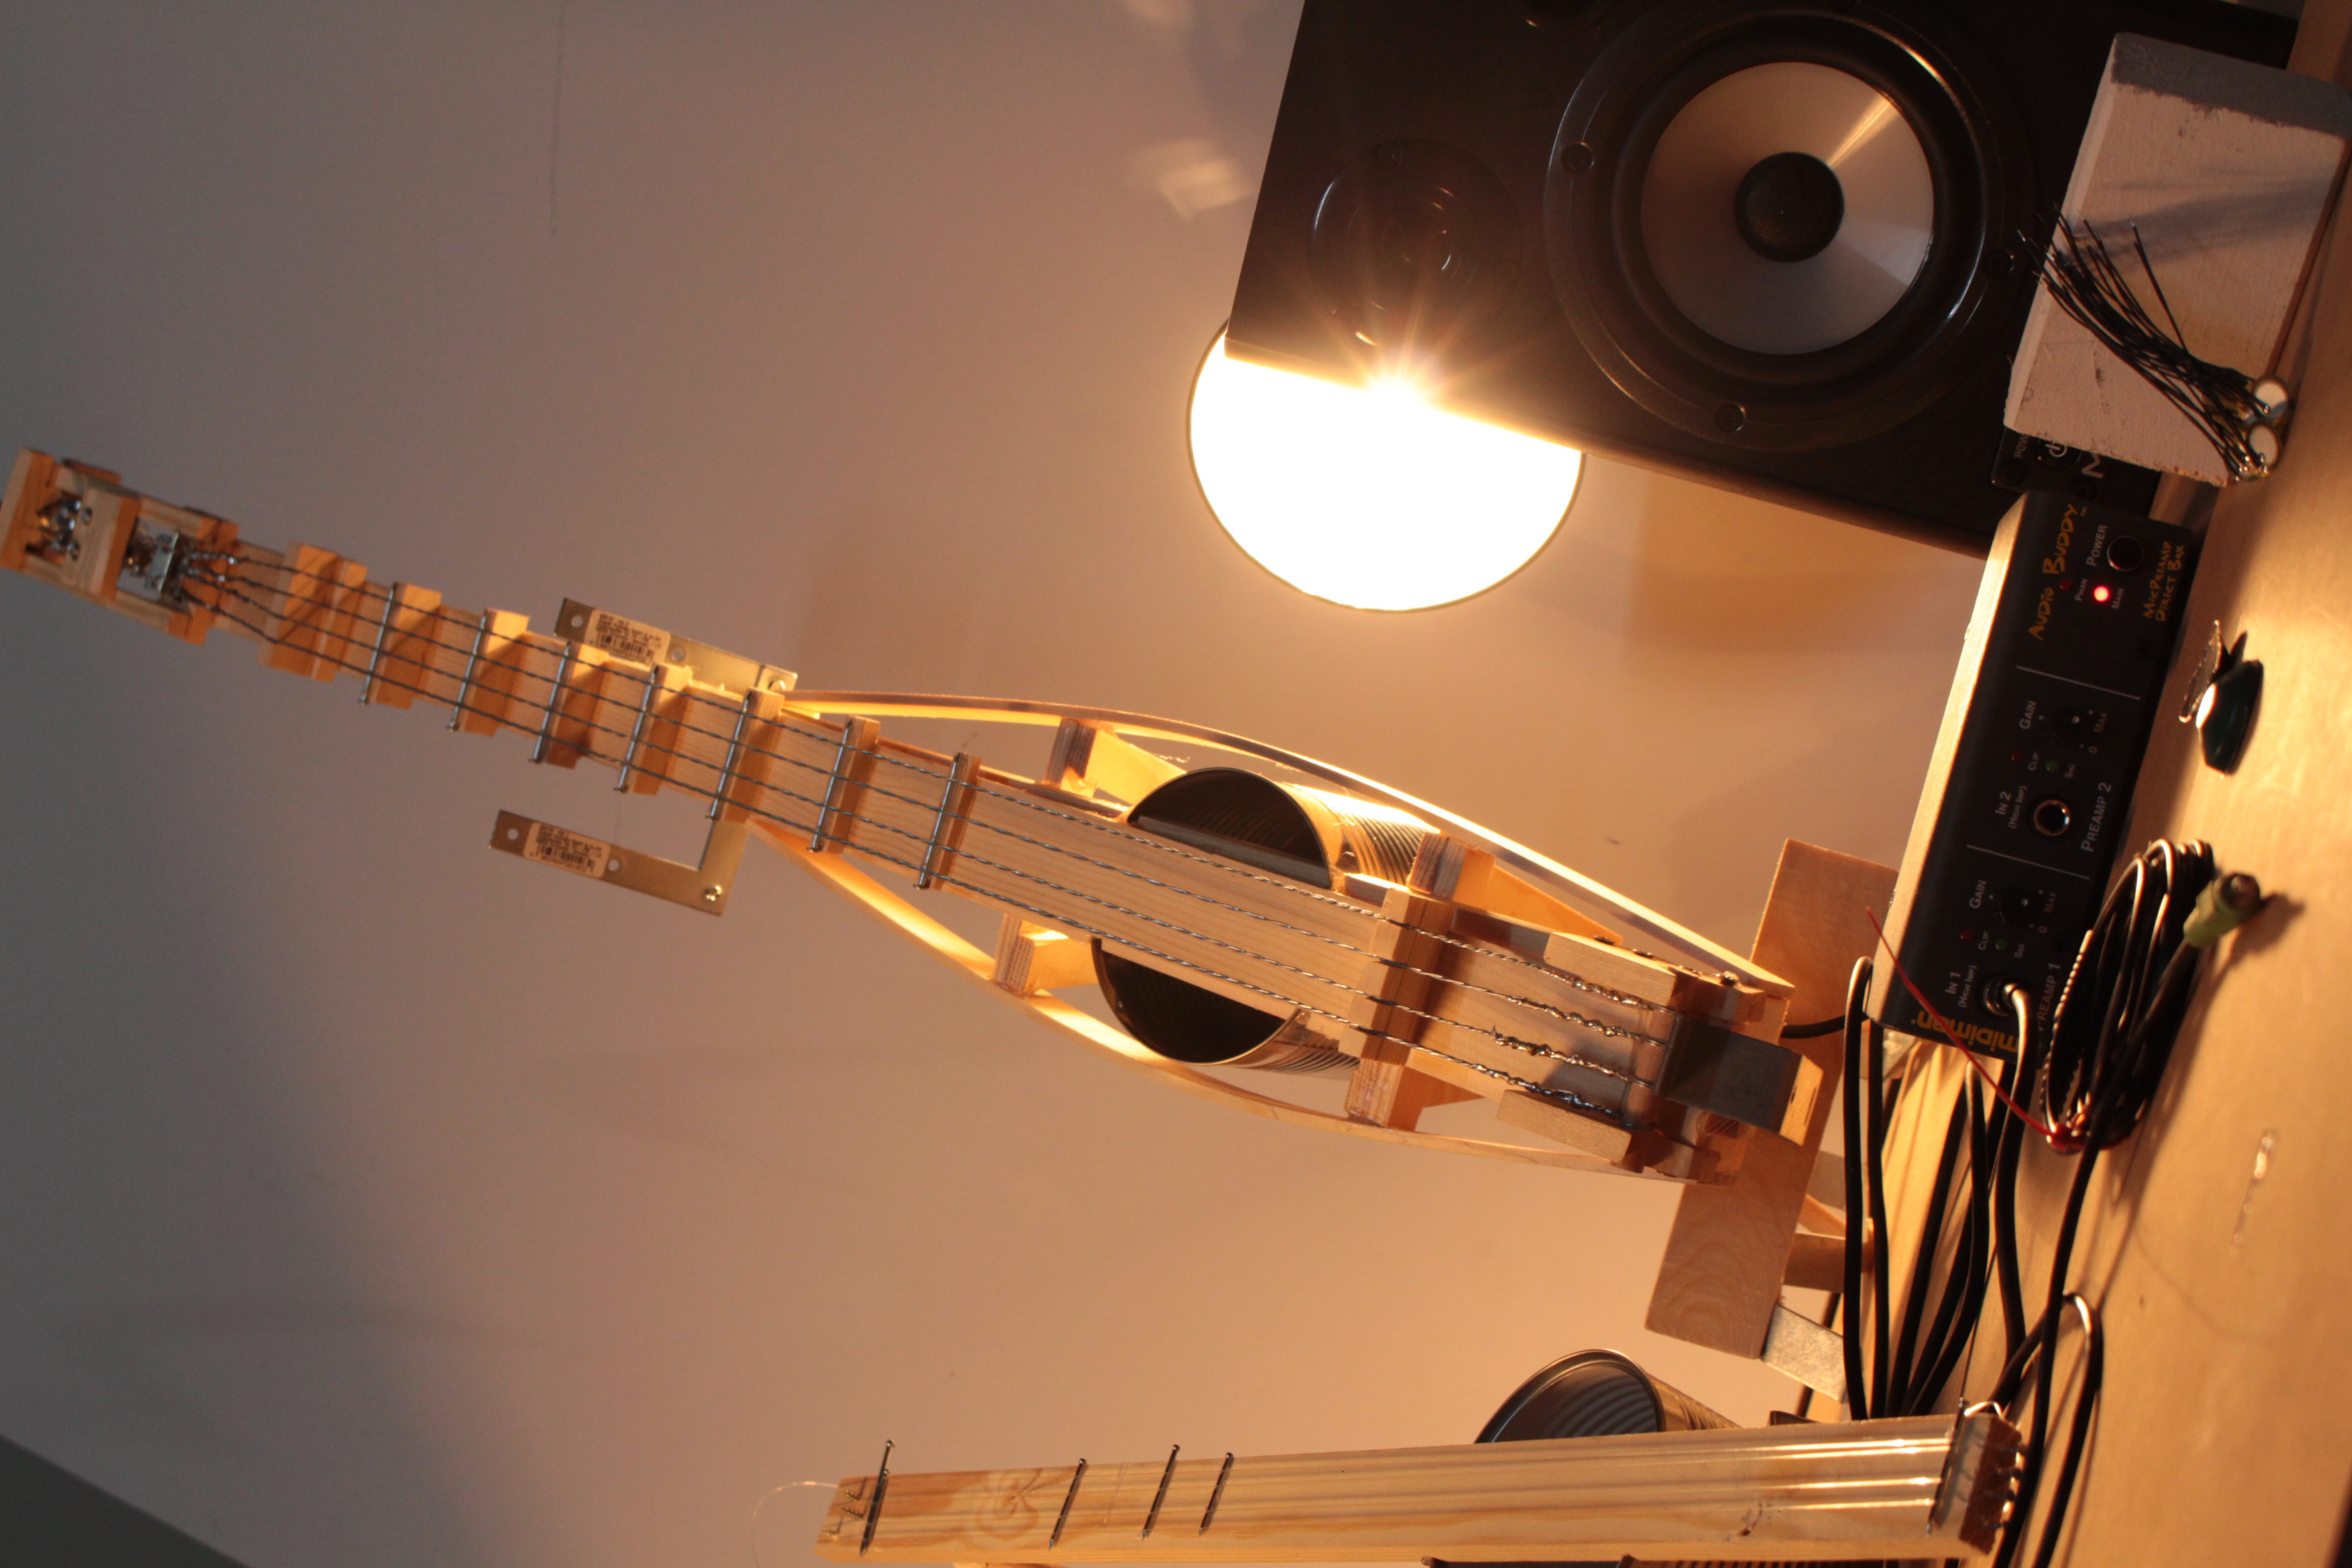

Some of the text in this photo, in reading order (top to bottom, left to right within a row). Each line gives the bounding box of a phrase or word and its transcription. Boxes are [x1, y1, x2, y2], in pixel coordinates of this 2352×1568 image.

[2043, 503, 2078, 575] BUDDY
[2086, 525, 2107, 567] POWER
[2074, 578, 2088, 602] PHAN
[2111, 587, 2123, 610] MAIN
[2019, 700, 2036, 729] GAIN
[2093, 711, 2107, 734] MAX
[2027, 751, 2040, 771] CLIP
[2064, 764, 2076, 779] SIG
[1995, 790, 2011, 816] IN 2
[2081, 782, 2112, 852] PREAMP 2
[1968, 880, 1987, 909] GAIN
[2044, 891, 2058, 914] MAX
[1977, 931, 1990, 951] CLIP
[2014, 943, 2025, 959] SIG
[2048, 963, 2061, 971] 1
[1945, 971, 1961, 997] IN 1
